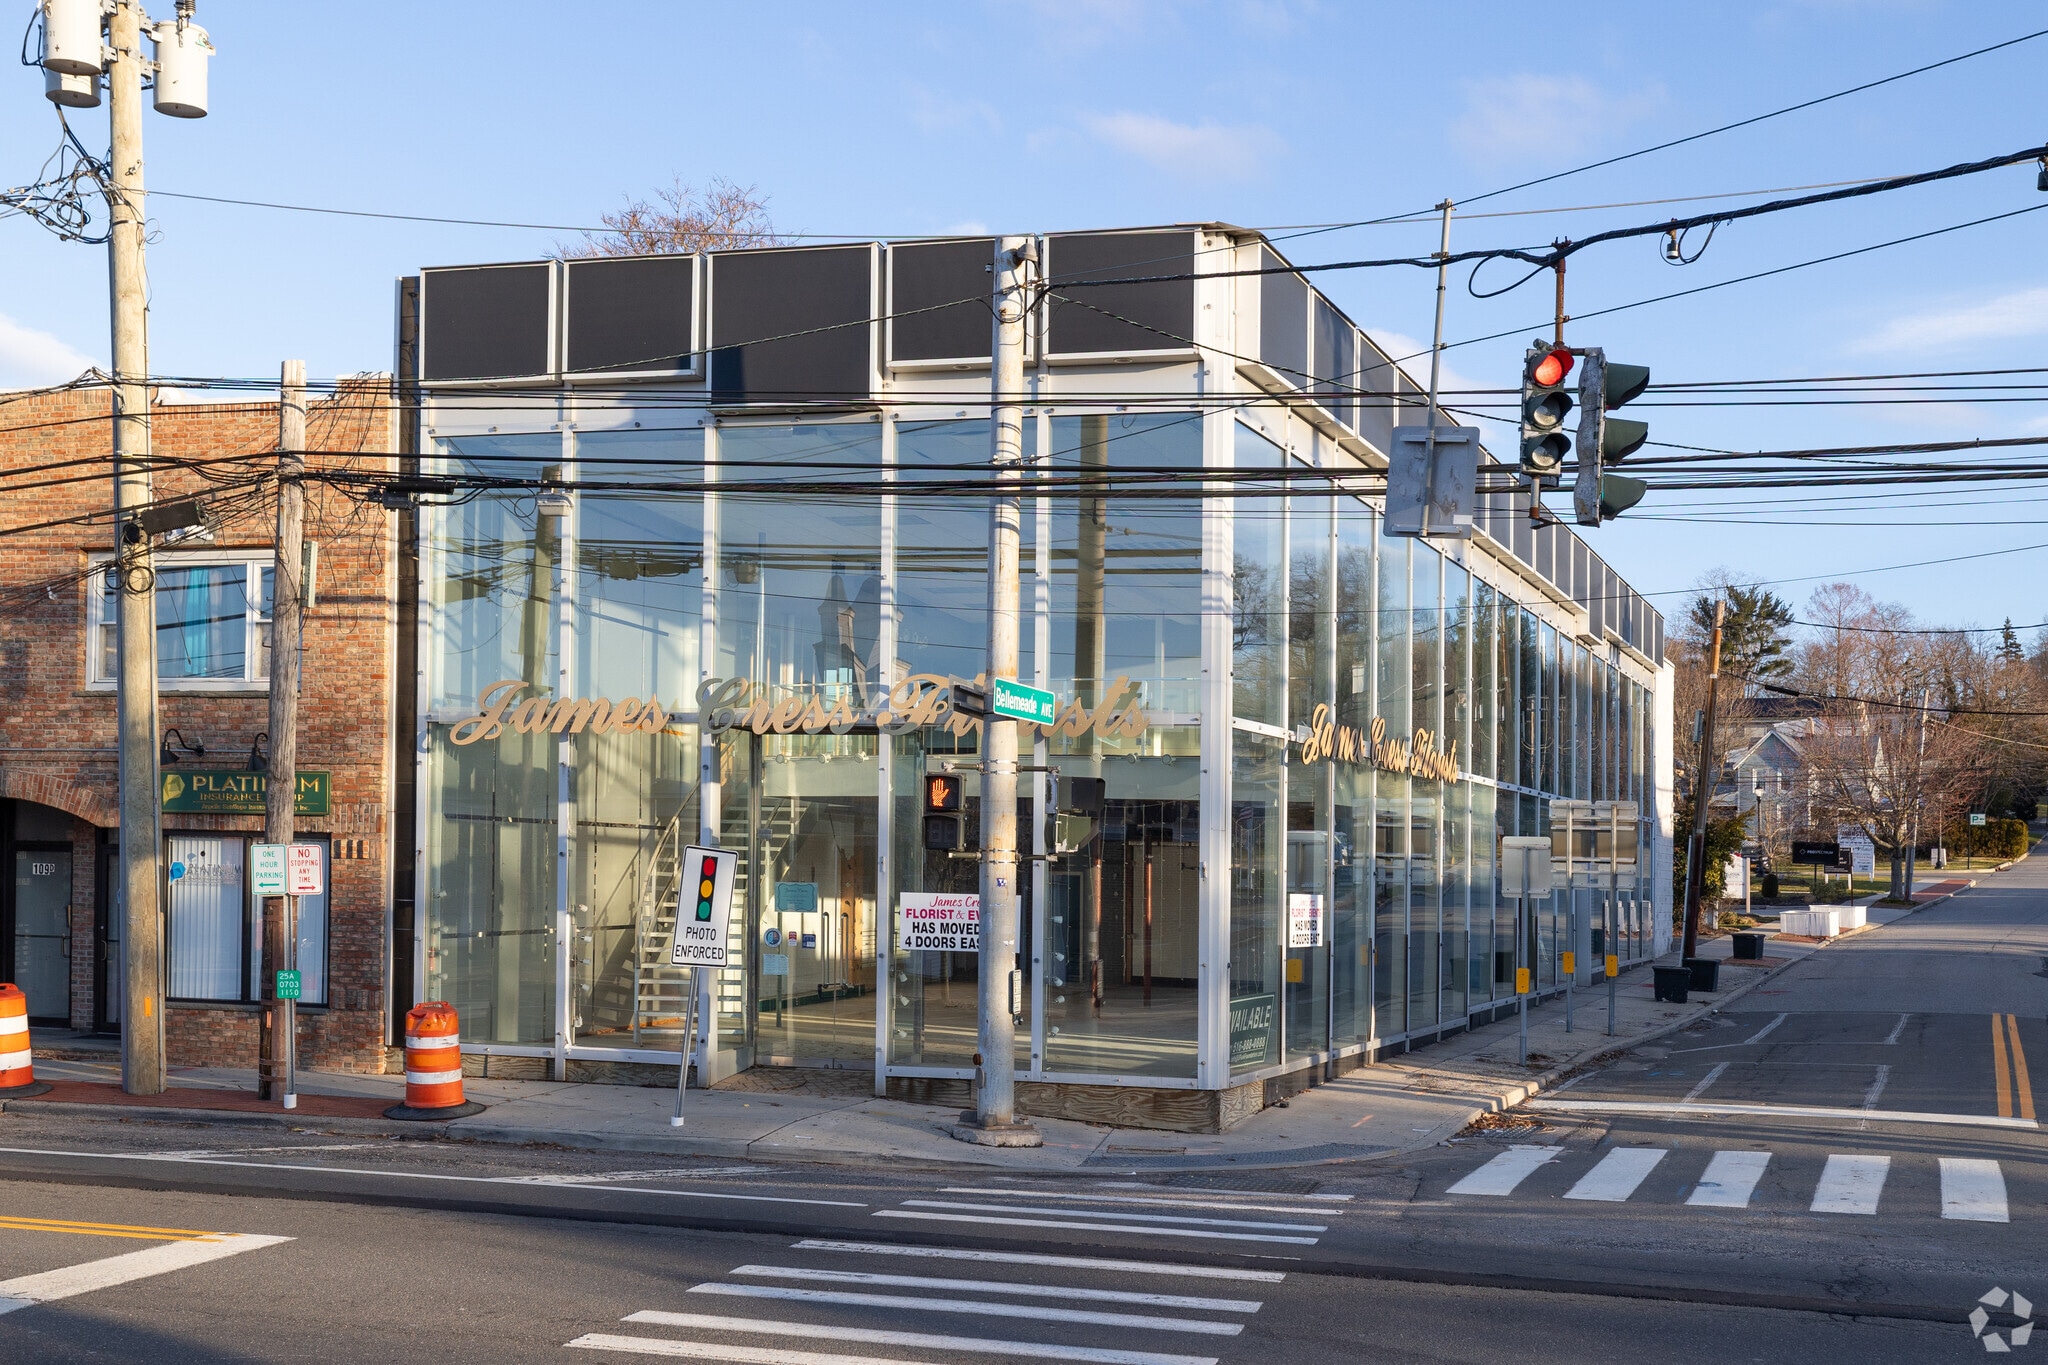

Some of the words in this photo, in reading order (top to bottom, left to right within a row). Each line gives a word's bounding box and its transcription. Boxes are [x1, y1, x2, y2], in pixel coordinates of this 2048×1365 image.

[996, 687, 1037, 714] Bellemeade
[1041, 702, 1053, 718] AVE
[450, 679, 675, 746] James
[695, 677, 859, 735] Cress
[1302, 703, 1367, 765] James
[1371, 717, 1407, 773] Cress
[1410, 728, 1458, 784] Florists
[193, 775, 320, 793] PLATIM
[200, 793, 262, 801] INSURANCE
[297, 848, 311, 858] NO
[929, 895, 963, 908] James
[905, 908, 955, 920] FLORIST
[955, 910, 965, 920] &
[685, 926, 717, 941] PHOTO
[912, 921, 936, 934] HAS
[939, 922, 980, 935] MOVED
[904, 935, 912, 947] 4
[915, 936, 956, 949] DOORS
[675, 944, 725, 960] ENFORCED
[279, 972, 295, 980] 25A
[1230, 1004, 1272, 1034] VAILABLE
